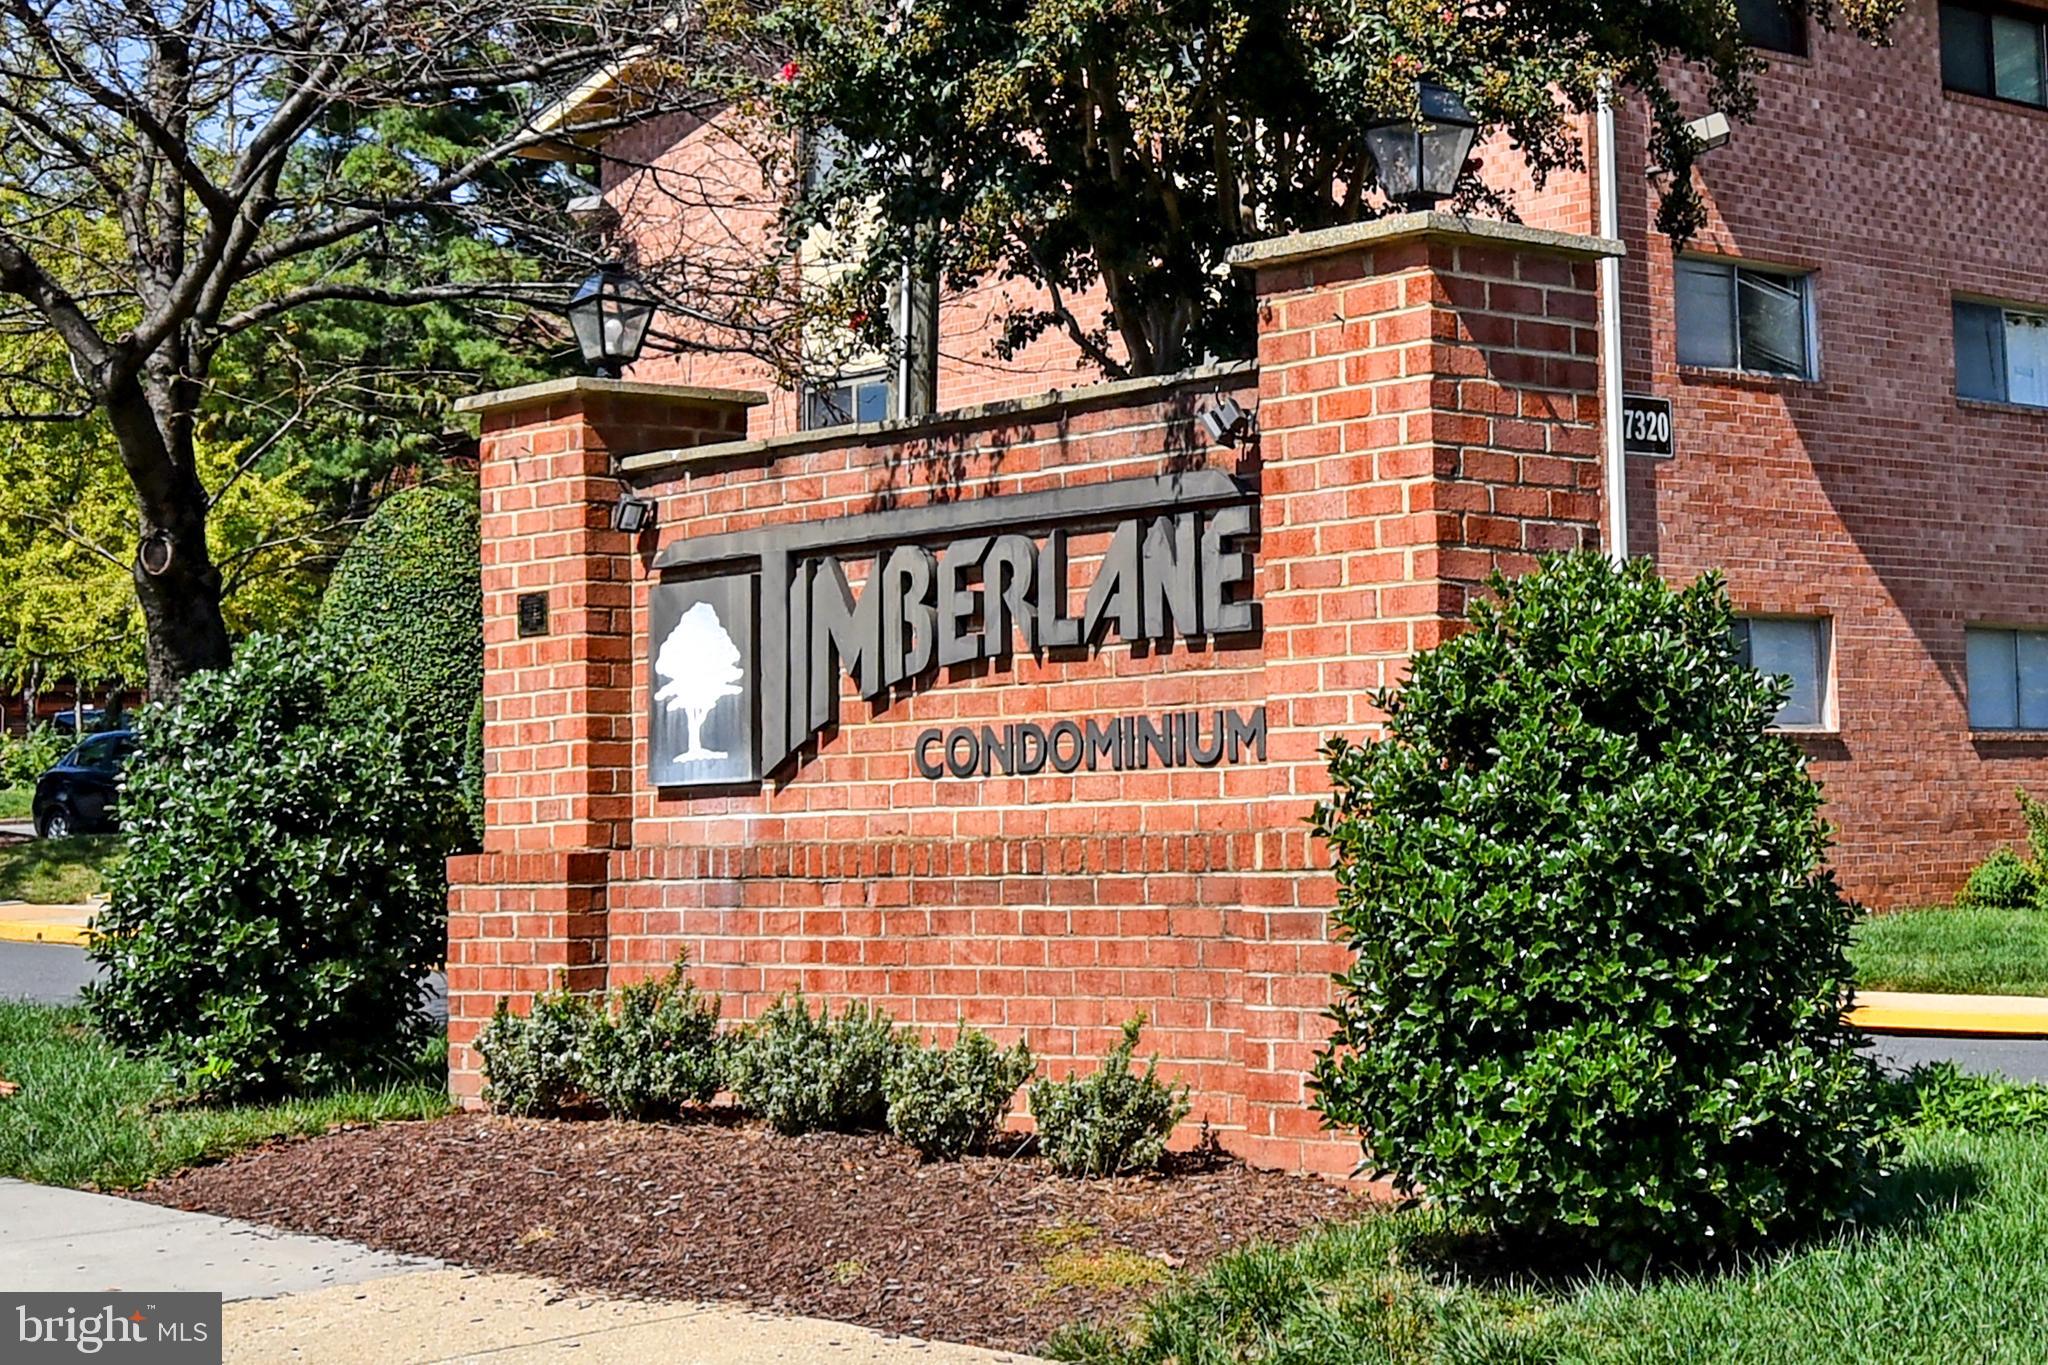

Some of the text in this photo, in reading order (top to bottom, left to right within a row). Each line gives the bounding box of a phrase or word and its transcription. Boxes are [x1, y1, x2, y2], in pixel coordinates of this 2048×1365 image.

[1624, 409, 1669, 443] 7320
[652, 468, 1256, 779] TIMBERLANE
[915, 705, 1268, 780] CONDOMINIUM
